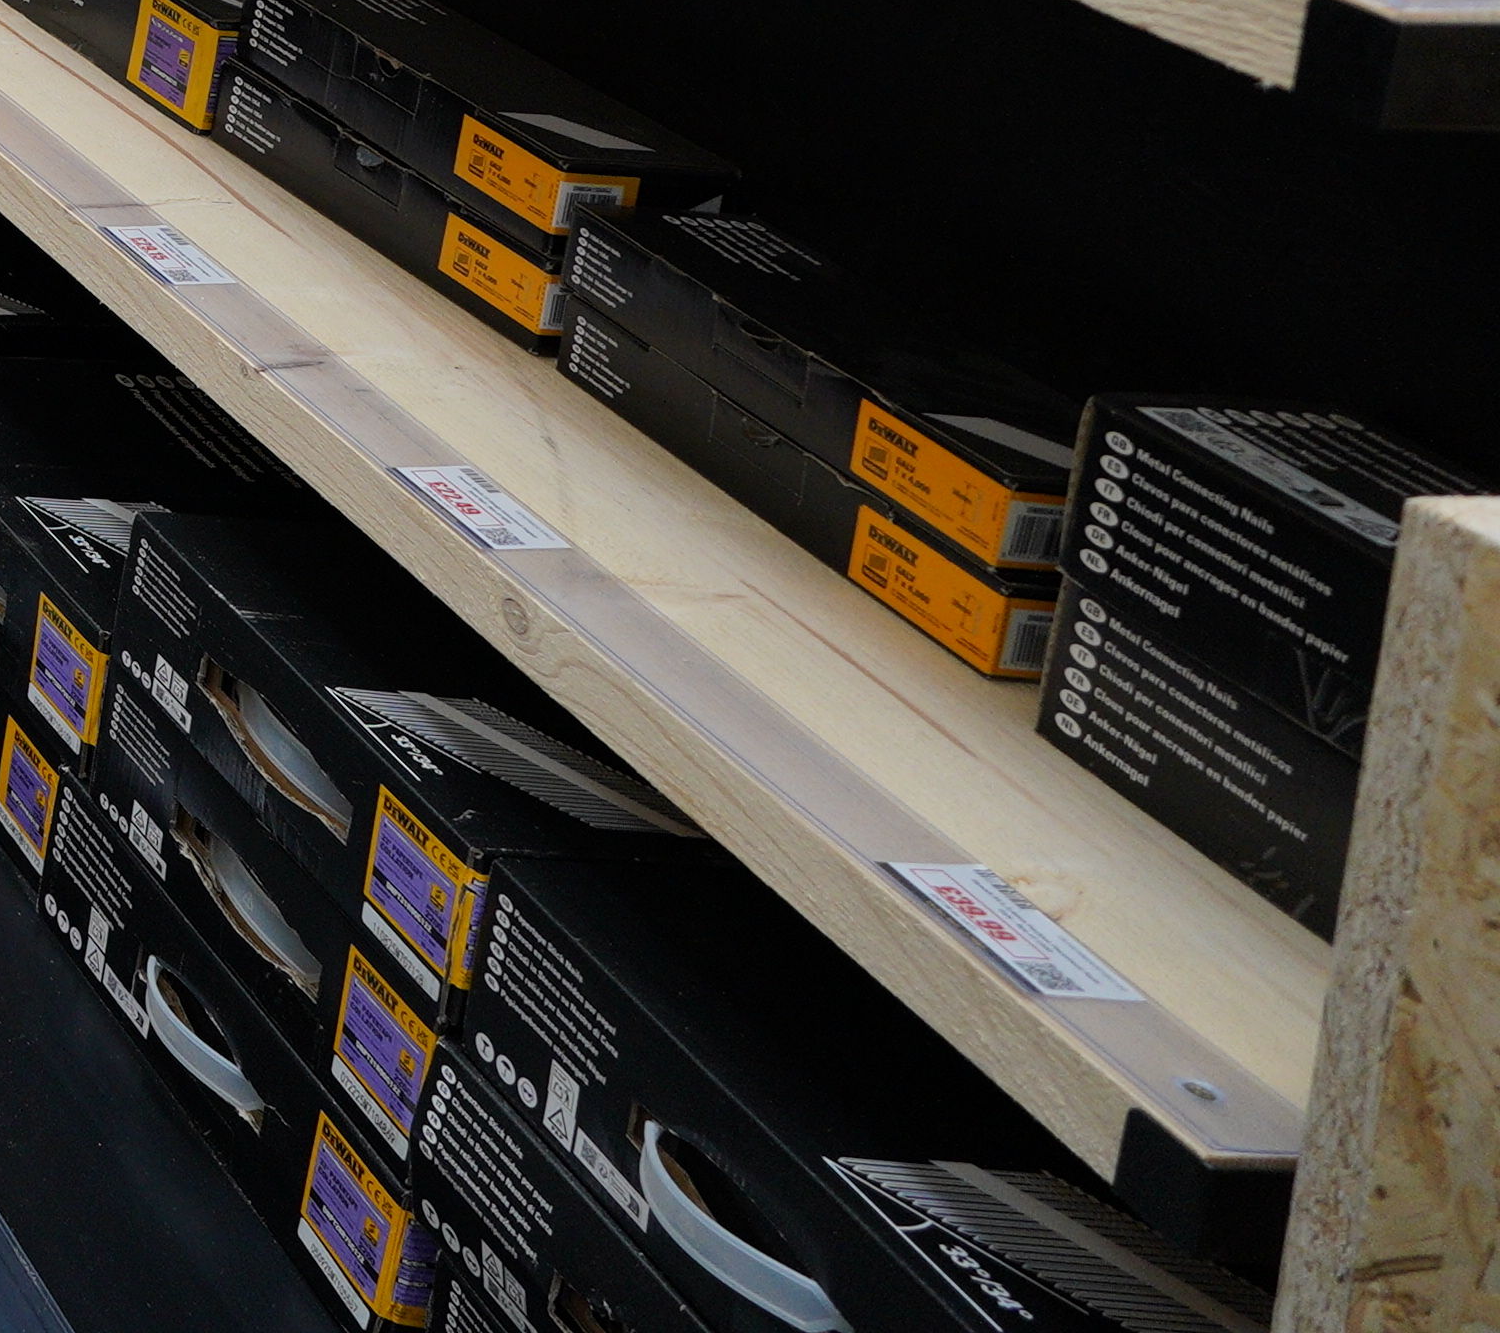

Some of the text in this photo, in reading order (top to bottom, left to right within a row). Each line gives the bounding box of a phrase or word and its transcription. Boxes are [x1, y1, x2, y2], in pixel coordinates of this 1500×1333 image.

[428, 481, 481, 516] £22.49
[1136, 447, 1171, 476] Metal
[1171, 468, 1239, 517] Connecting
[1239, 507, 1275, 536] Nails
[1114, 544, 1189, 599] Anker-Nägel
[1125, 496, 1164, 527] Chiodi
[1163, 520, 1185, 541] per
[1186, 531, 1248, 576] connettori
[1248, 567, 1305, 610] metallici
[1130, 472, 1170, 504] Clavos
[1170, 497, 1198, 523] para
[1200, 513, 1268, 560] conectores
[1268, 551, 1332, 598] metálicos
[1109, 568, 1180, 621] Ankernagel
[1120, 519, 1154, 548] Clous
[1154, 541, 1182, 566] pour
[1182, 557, 1238, 600] ancrages
[1240, 592, 1257, 609] en
[1257, 601, 1304, 637] bandes
[1305, 630, 1349, 667] papier
[1085, 602, 1238, 711] GB Metal Connecting Nails
[1066, 693, 1159, 765] DE Anker-Nägel
[1077, 650, 1269, 786] IT Chiodi per connettori metallici
[1080, 626, 1294, 776] ES Clavos para conectores metálicos
[1062, 716, 1151, 787] NL Ankernagel
[1070, 673, 1308, 844] FR Clous pour ancrages en bandes papier
[512, 908, 584, 984] Papertape Stick Nails
[932, 883, 1019, 944] £39.99
[939, 1243, 1034, 1320] 33°/34°
